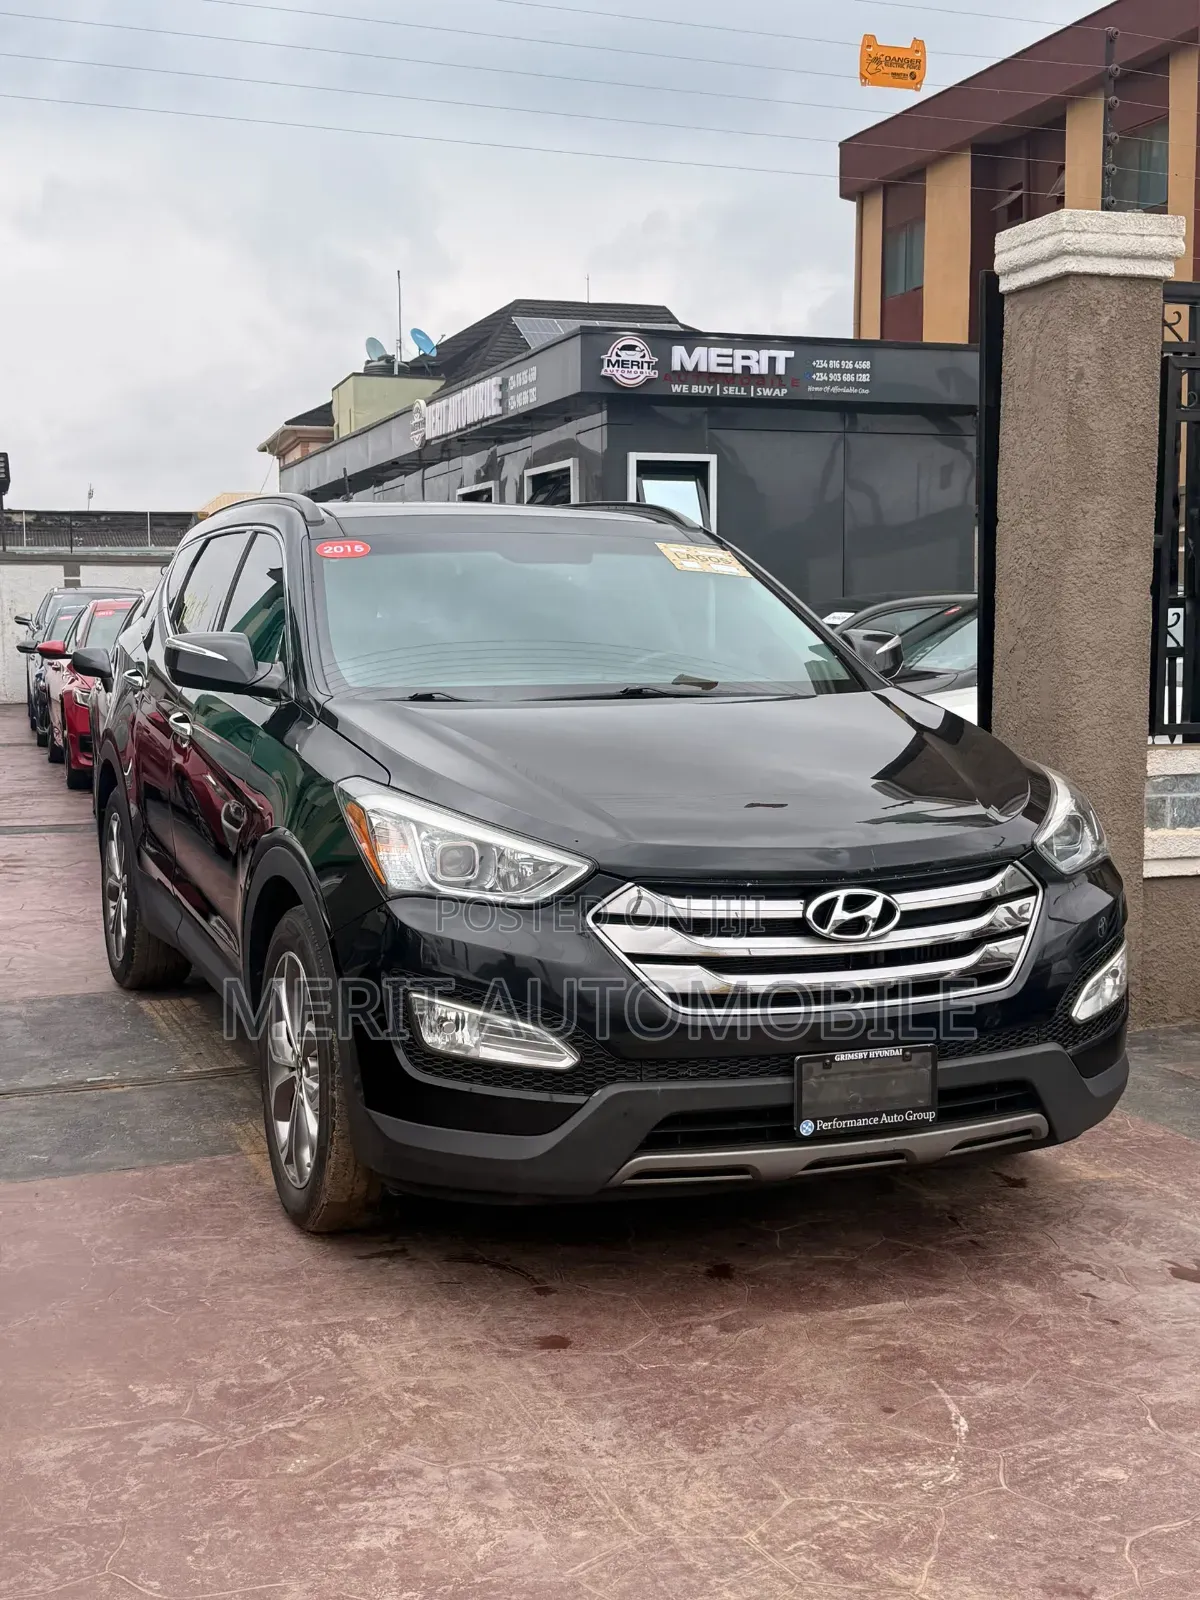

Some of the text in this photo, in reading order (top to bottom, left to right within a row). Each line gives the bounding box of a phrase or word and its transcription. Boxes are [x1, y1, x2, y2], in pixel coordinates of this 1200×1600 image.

[884, 56, 922, 64] DANGER
[606, 358, 654, 370] MERIT
[671, 345, 795, 376] MERIT
[812, 360, 872, 370] +234 816 926 4568
[662, 372, 801, 388] AUTOMOBILE
[812, 372, 870, 382] +234 903 686 1282
[671, 384, 788, 397] WE BUY SELL SWAP
[426, 376, 502, 440] MERIT AUTOMOBILE
[324, 544, 364, 554] 2015
[674, 552, 732, 564] LAGOS
[834, 1048, 903, 1062] GRIMSBY HYUNDAI
[816, 1110, 936, 1131] Performance Auto Group
